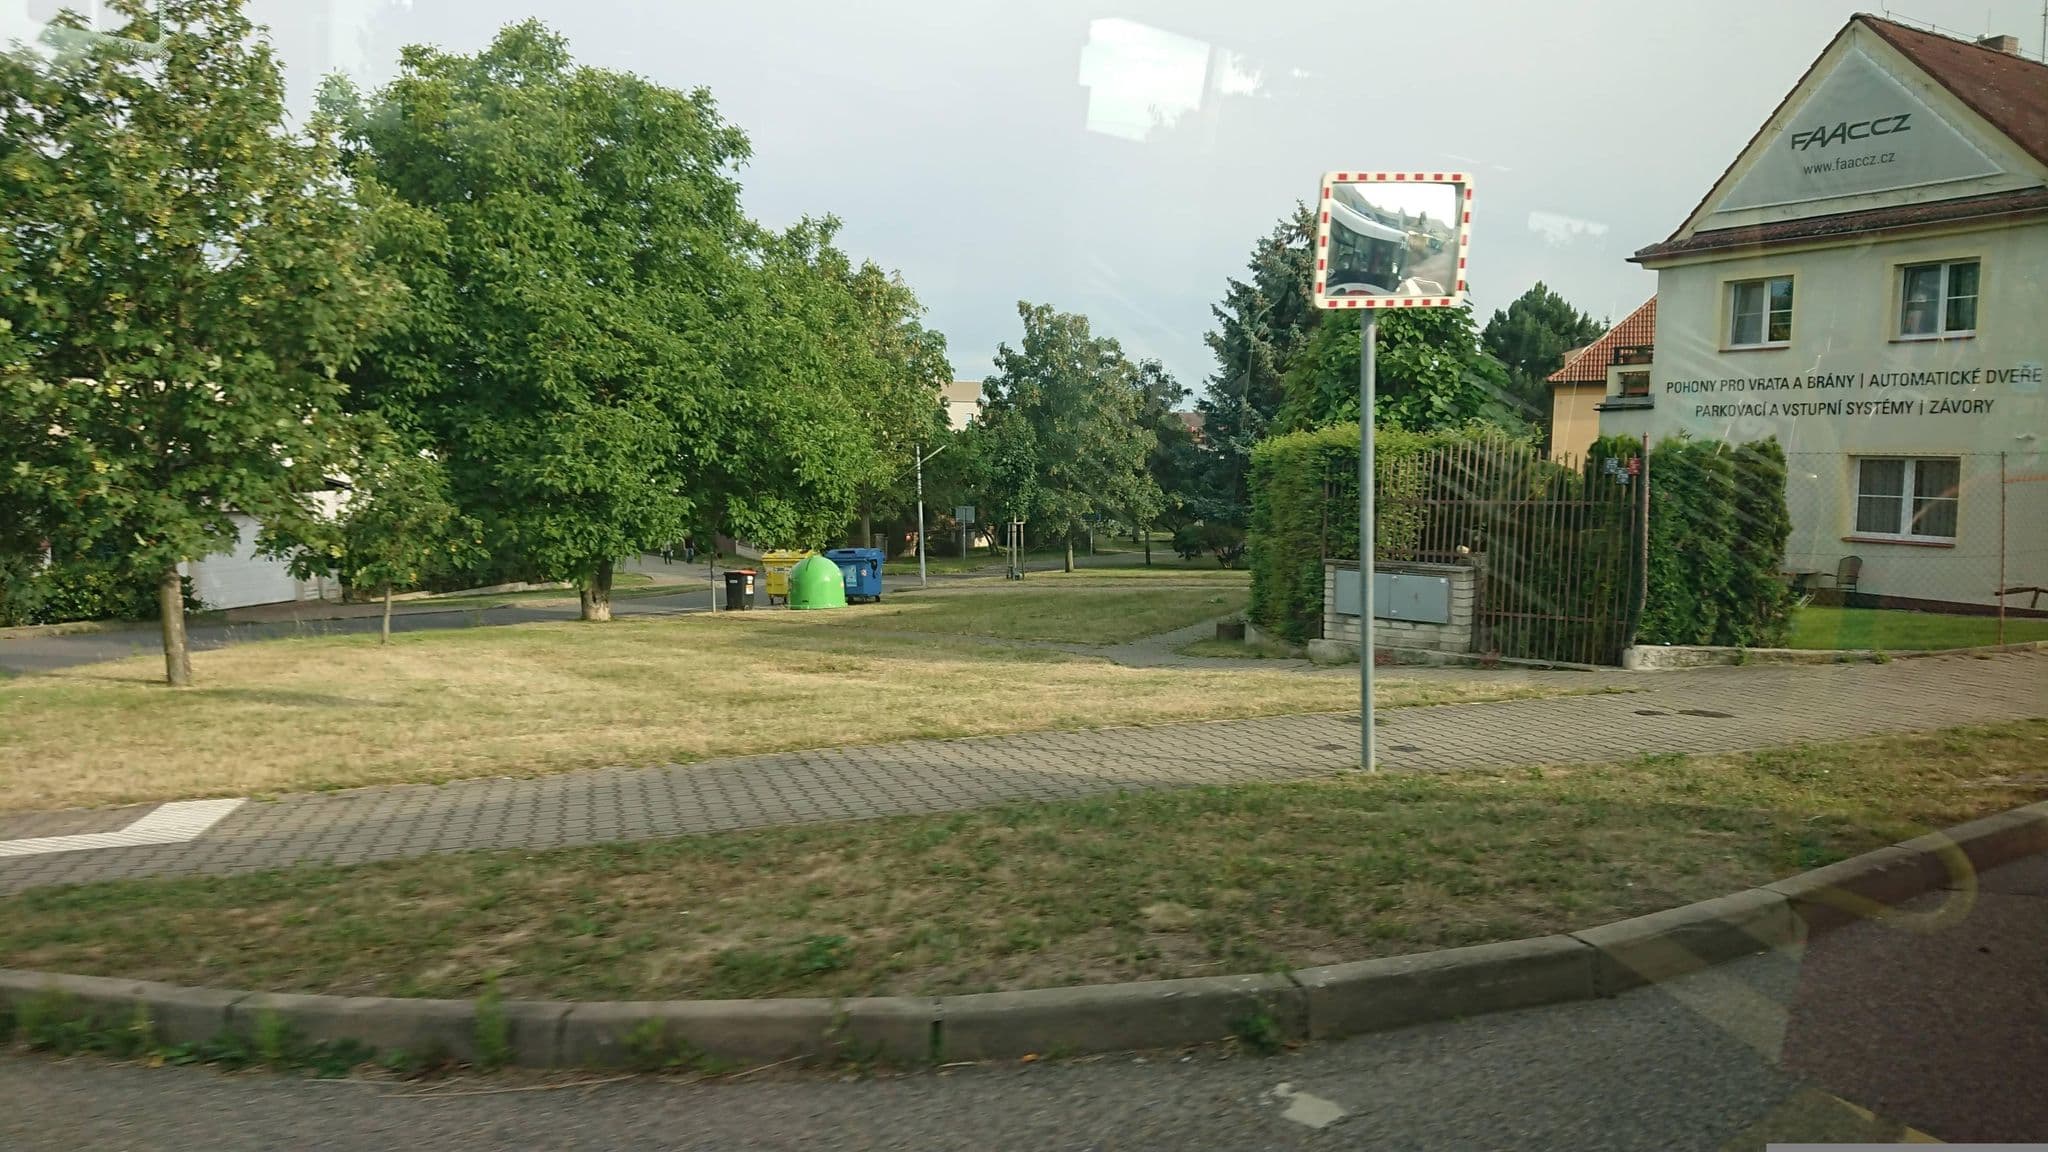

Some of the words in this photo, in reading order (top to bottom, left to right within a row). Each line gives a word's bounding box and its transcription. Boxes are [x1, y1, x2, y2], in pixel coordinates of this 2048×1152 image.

[1791, 113, 1912, 151] FAACCZ
[1803, 152, 1896, 175] www.faaccz.cz
[1666, 380, 1717, 394] POHONY
[1719, 378, 1745, 392] PRO
[1748, 377, 1790, 391] VRATA
[1792, 376, 1803, 390] A
[1807, 373, 1856, 390] BRÁNY
[1869, 368, 1982, 387] AUTOMATICKÉ
[1986, 365, 2043, 384] DVEŘE
[1695, 401, 1767, 418] PARKOVACÍ
[1769, 404, 1779, 417] A
[1782, 400, 1844, 417] VSTUPNÍ
[1846, 399, 1914, 415] SYSTÉMY
[1929, 398, 1995, 414] ZÁVORY
